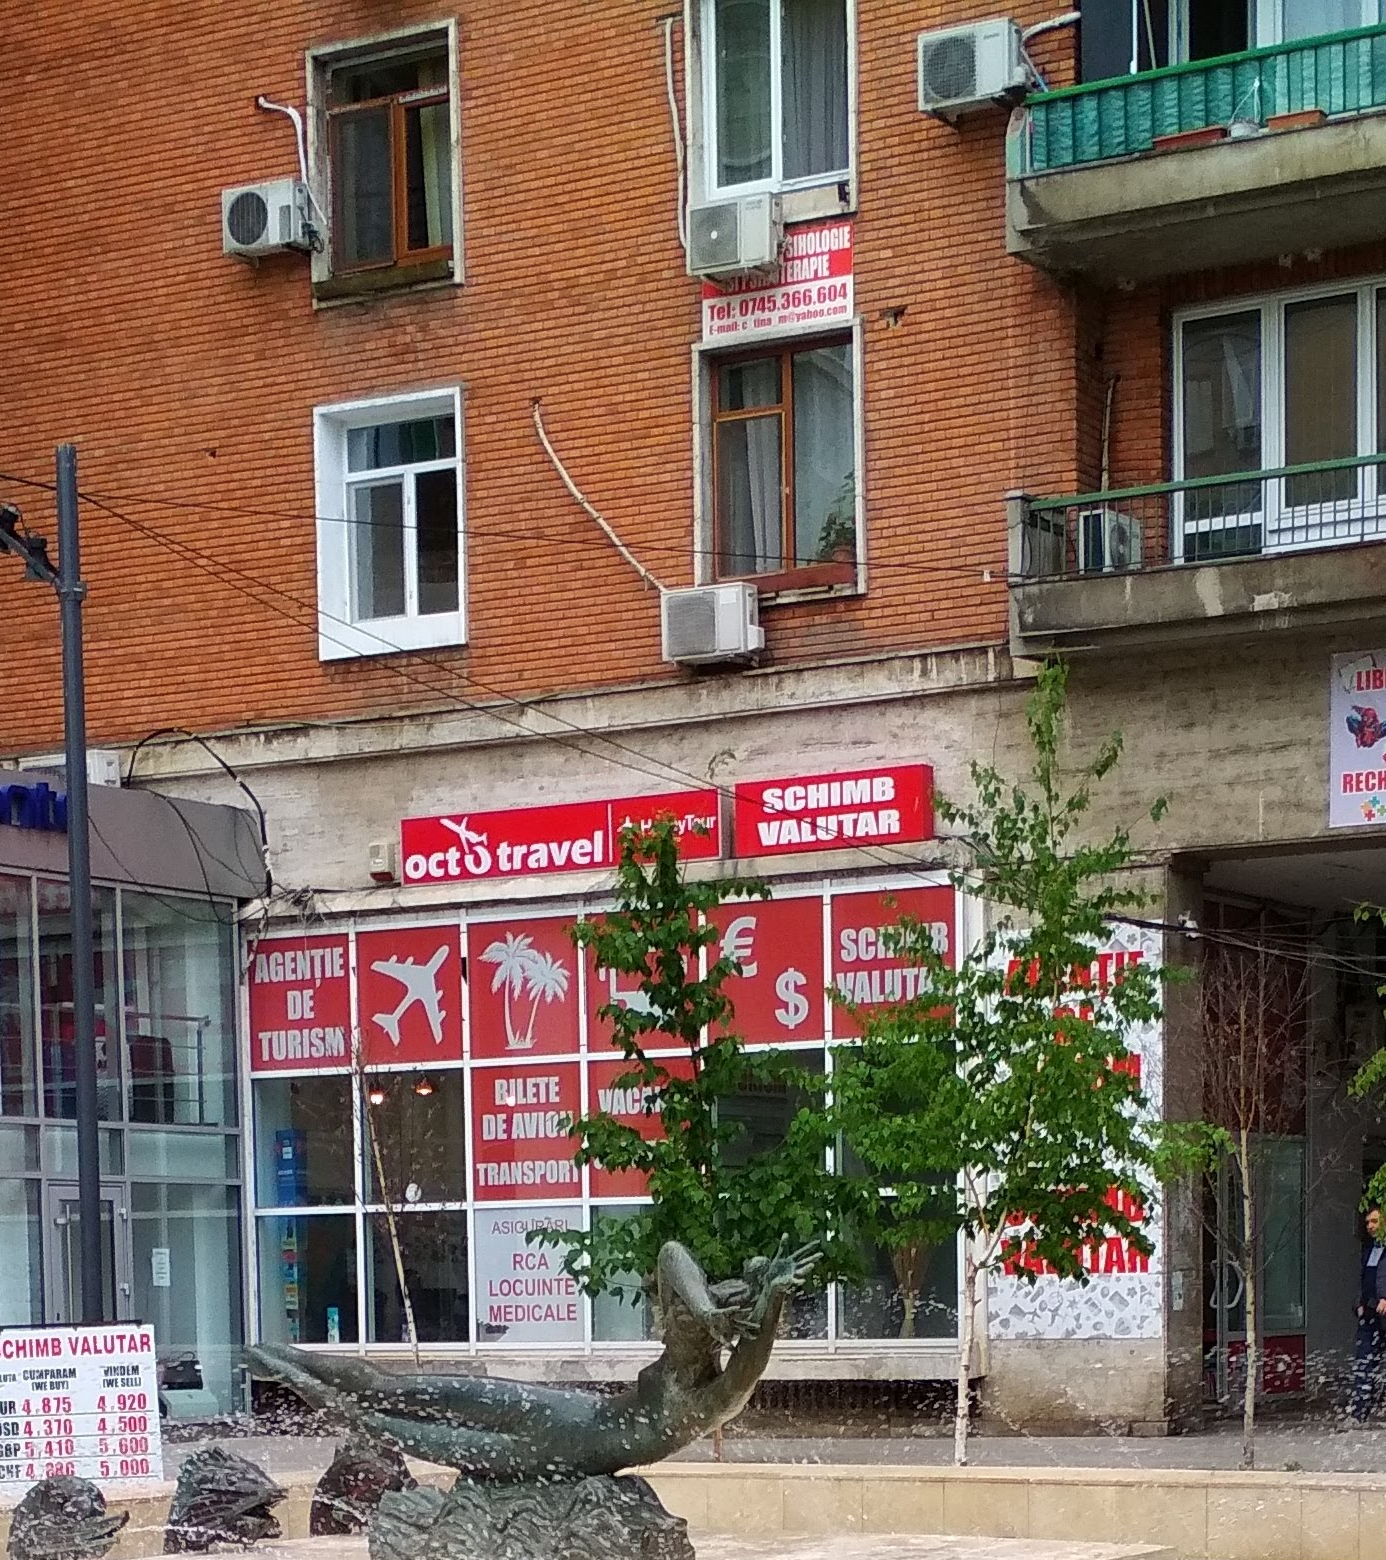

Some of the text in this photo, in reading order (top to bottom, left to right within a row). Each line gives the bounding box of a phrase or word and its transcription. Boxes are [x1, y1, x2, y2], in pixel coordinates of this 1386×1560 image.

[783, 225, 851, 259] SIHOLOGIE
[707, 282, 848, 321] Tel: 0745.366.604
[761, 776, 896, 814] SCHIMB
[756, 809, 901, 847] VALUTAR
[496, 829, 604, 871] travel
[836, 966, 941, 1005] VALUTA
[286, 988, 315, 1020] DE
[257, 1026, 345, 1062] TURISM
[494, 1076, 561, 1107] BILETE
[482, 1110, 574, 1142] DE AVION
[476, 1159, 579, 1187] TRANSPORT
[512, 1252, 550, 1271] RCA
[488, 1277, 576, 1297] LOCUINTE
[488, 1303, 578, 1323] MEDICALE
[67, 1333, 152, 1356] VALUTAR
[22, 1367, 77, 1381] CUMPARAM
